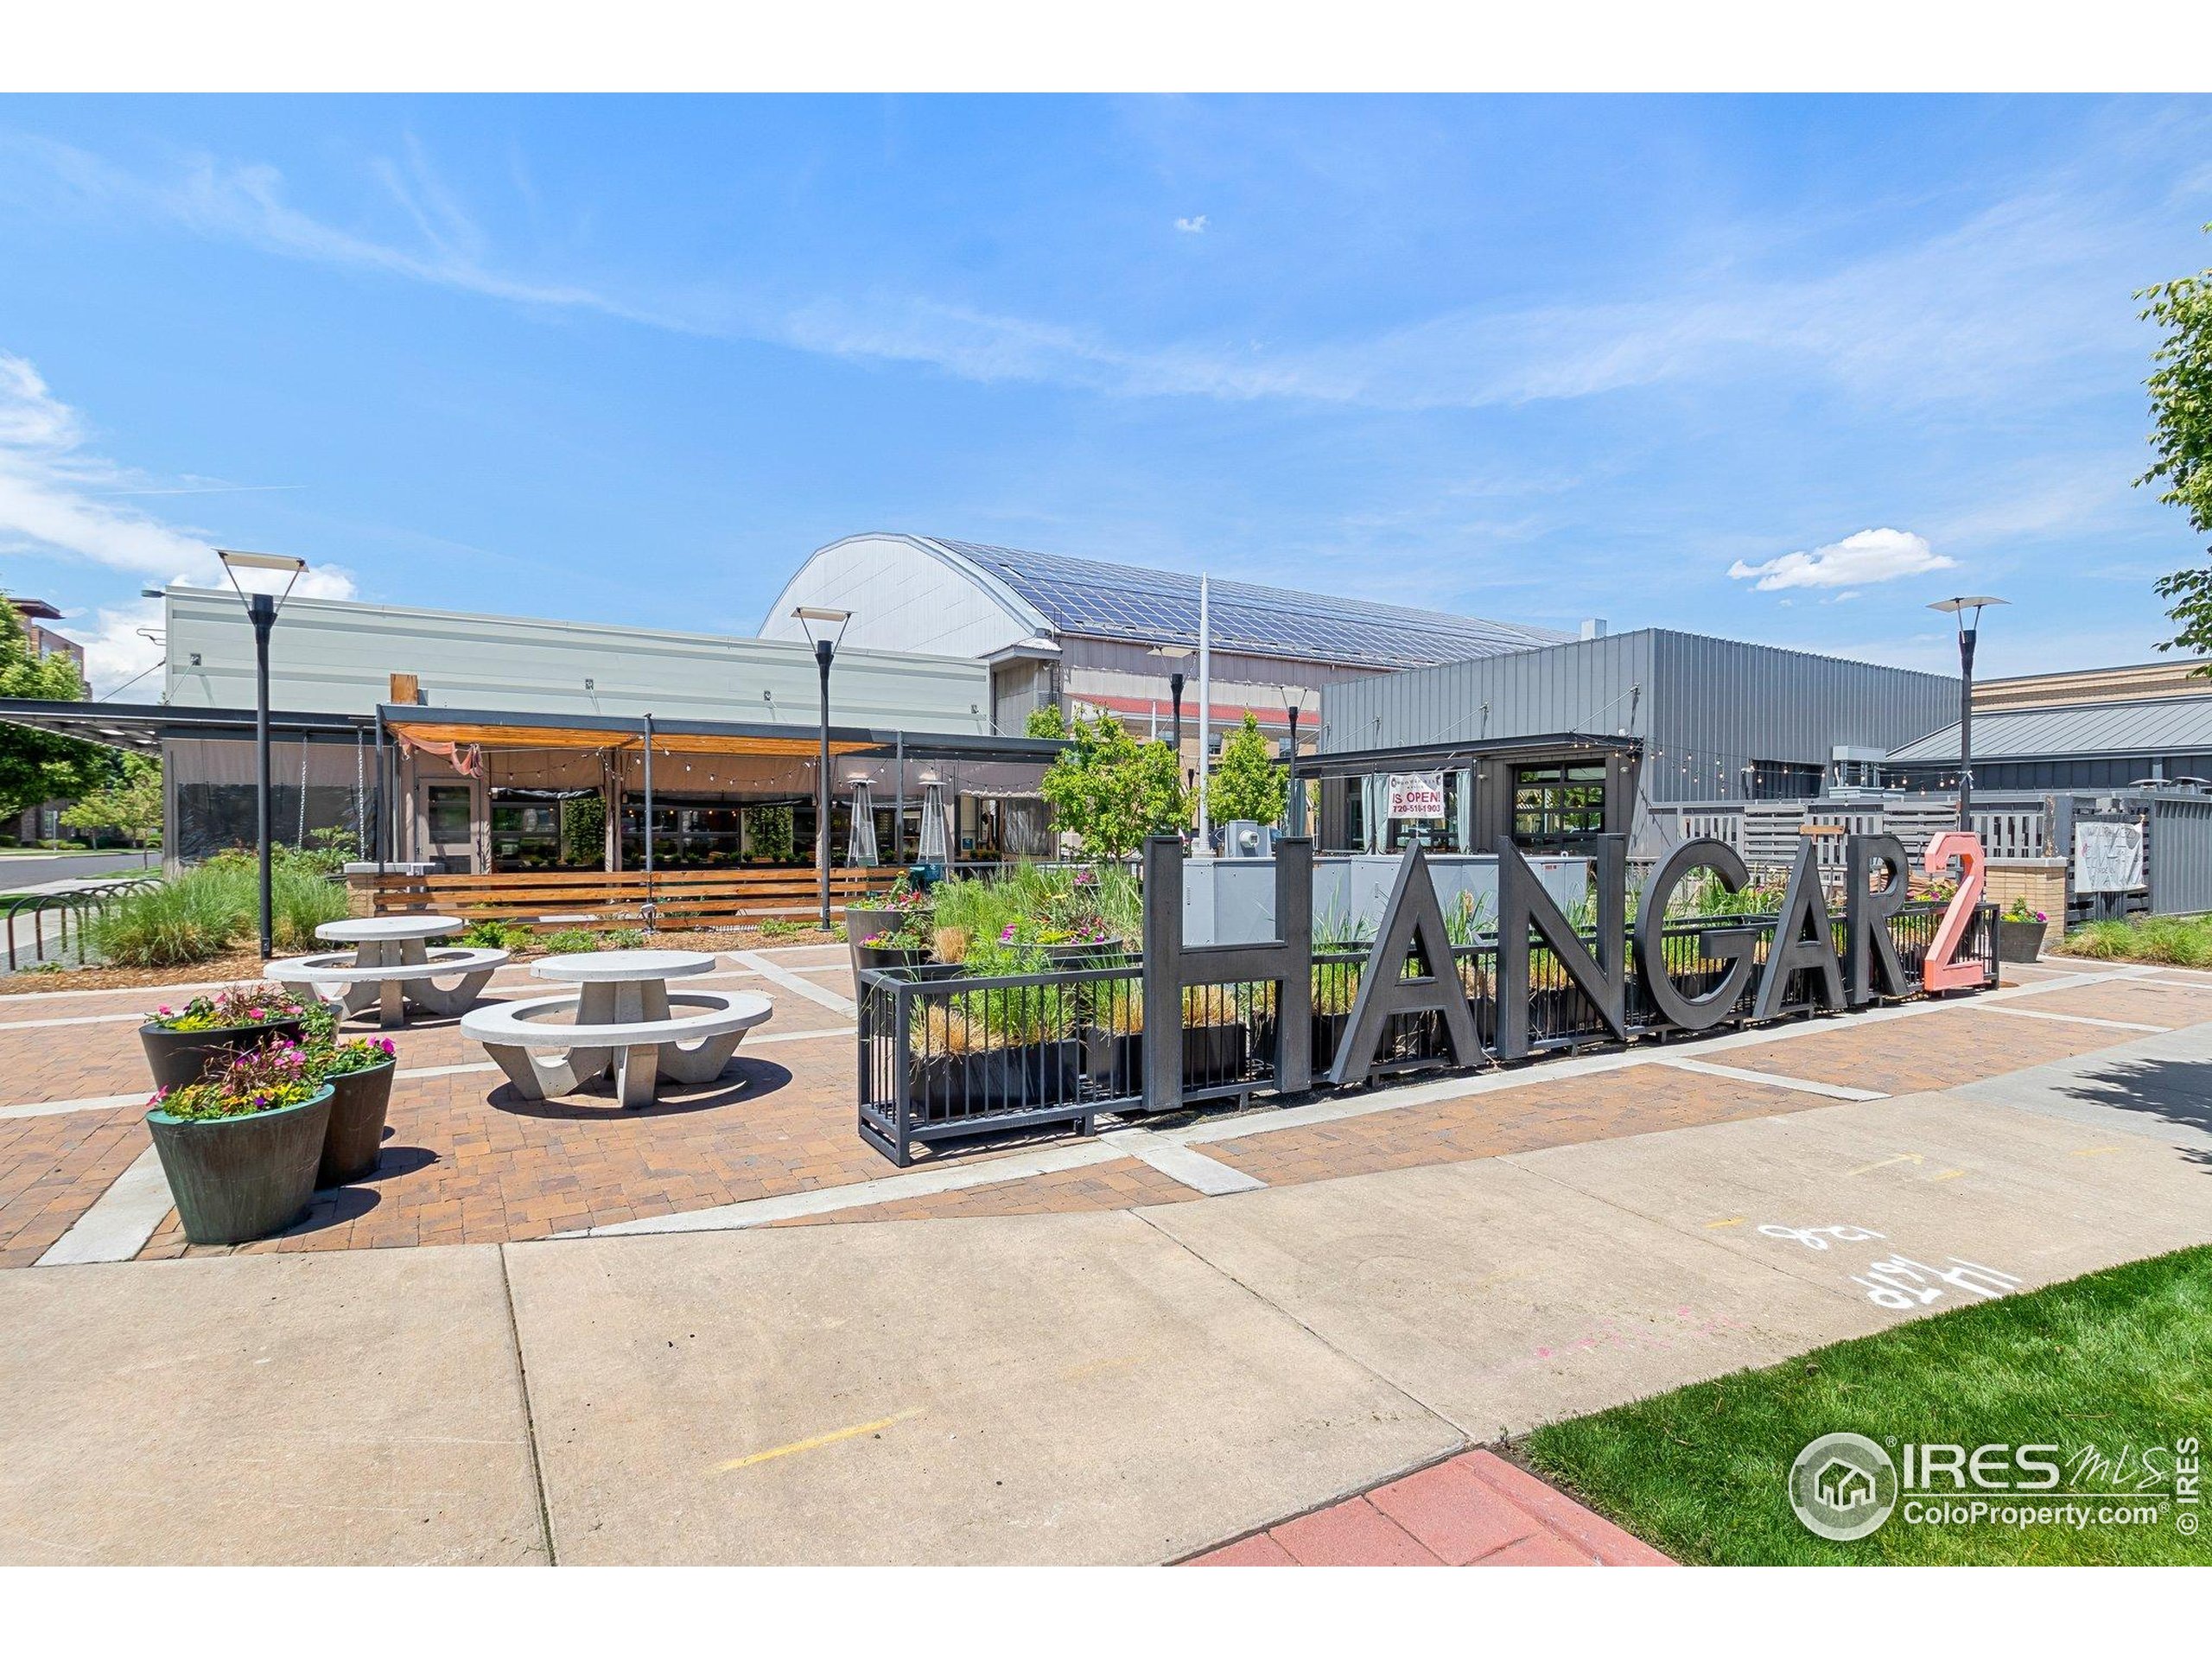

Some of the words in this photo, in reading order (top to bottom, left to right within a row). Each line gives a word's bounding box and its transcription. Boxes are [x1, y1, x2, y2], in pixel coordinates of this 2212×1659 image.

[1392, 792, 1403, 804] IS
[1406, 791, 1440, 803] OPEN!
[1142, 834, 1909, 1111] HANGAR
[1923, 831, 1986, 992] 2
